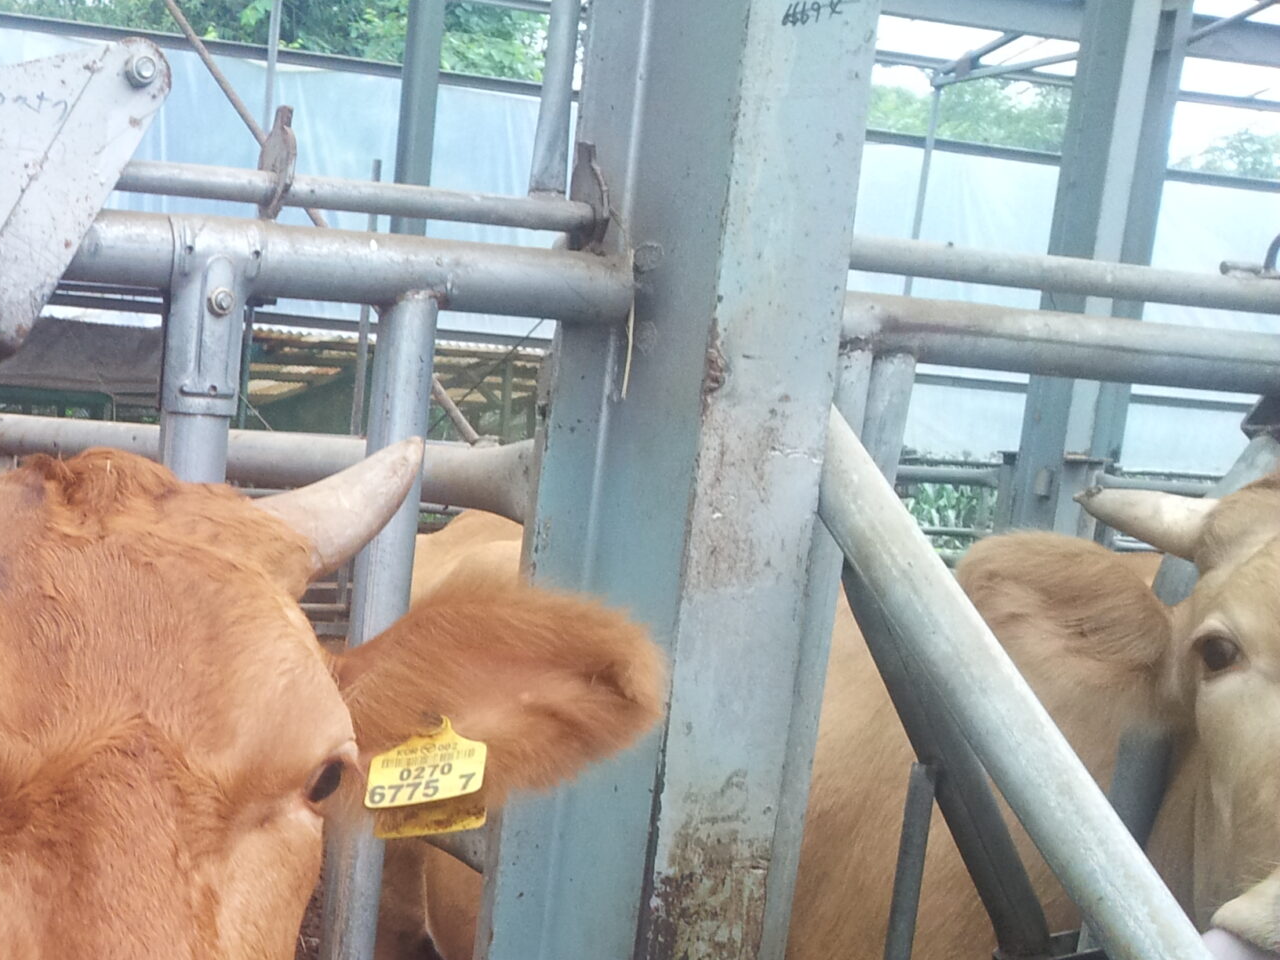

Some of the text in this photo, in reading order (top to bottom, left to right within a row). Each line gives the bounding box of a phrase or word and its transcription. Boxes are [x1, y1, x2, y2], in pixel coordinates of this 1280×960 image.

[399, 763, 453, 782] 0270
[368, 772, 476, 805] 6775 7
